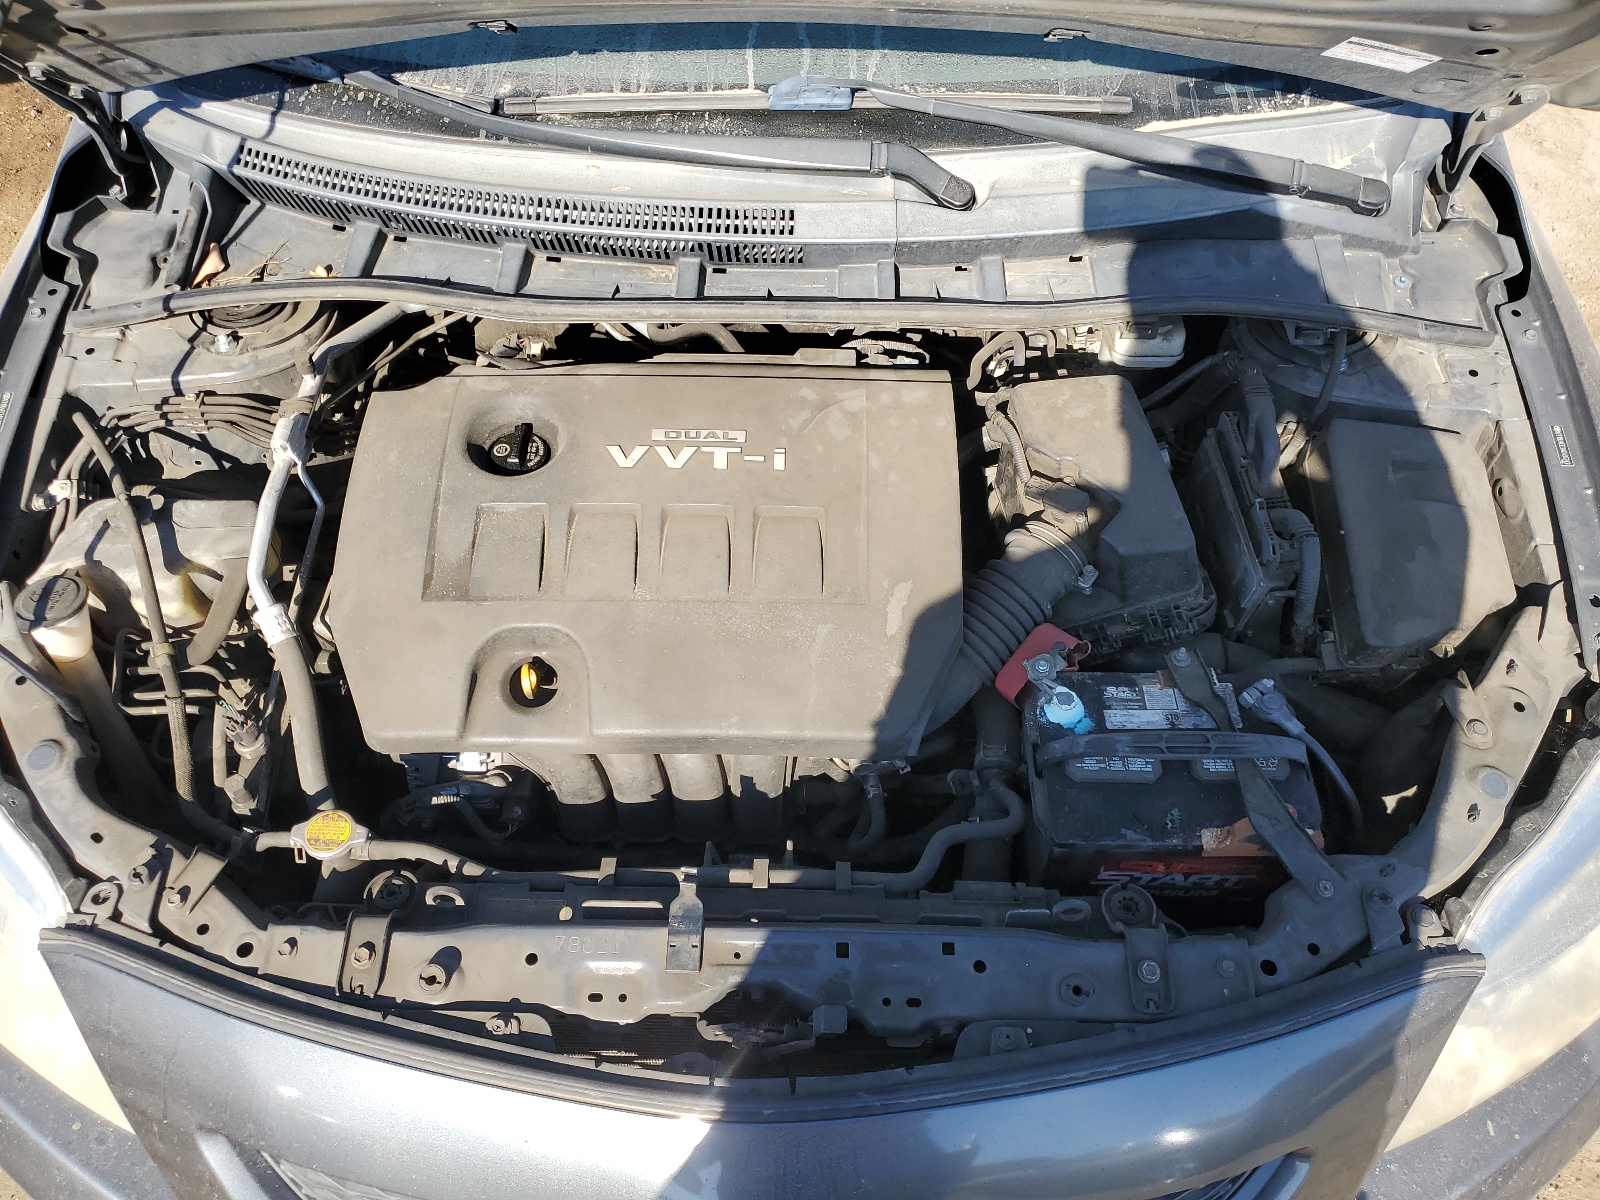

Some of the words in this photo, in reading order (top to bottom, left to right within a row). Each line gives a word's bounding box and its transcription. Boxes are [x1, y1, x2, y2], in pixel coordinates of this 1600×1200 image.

[663, 429, 740, 440] DUAL
[605, 444, 787, 471] VVT-i
[1092, 871, 1257, 887] START
